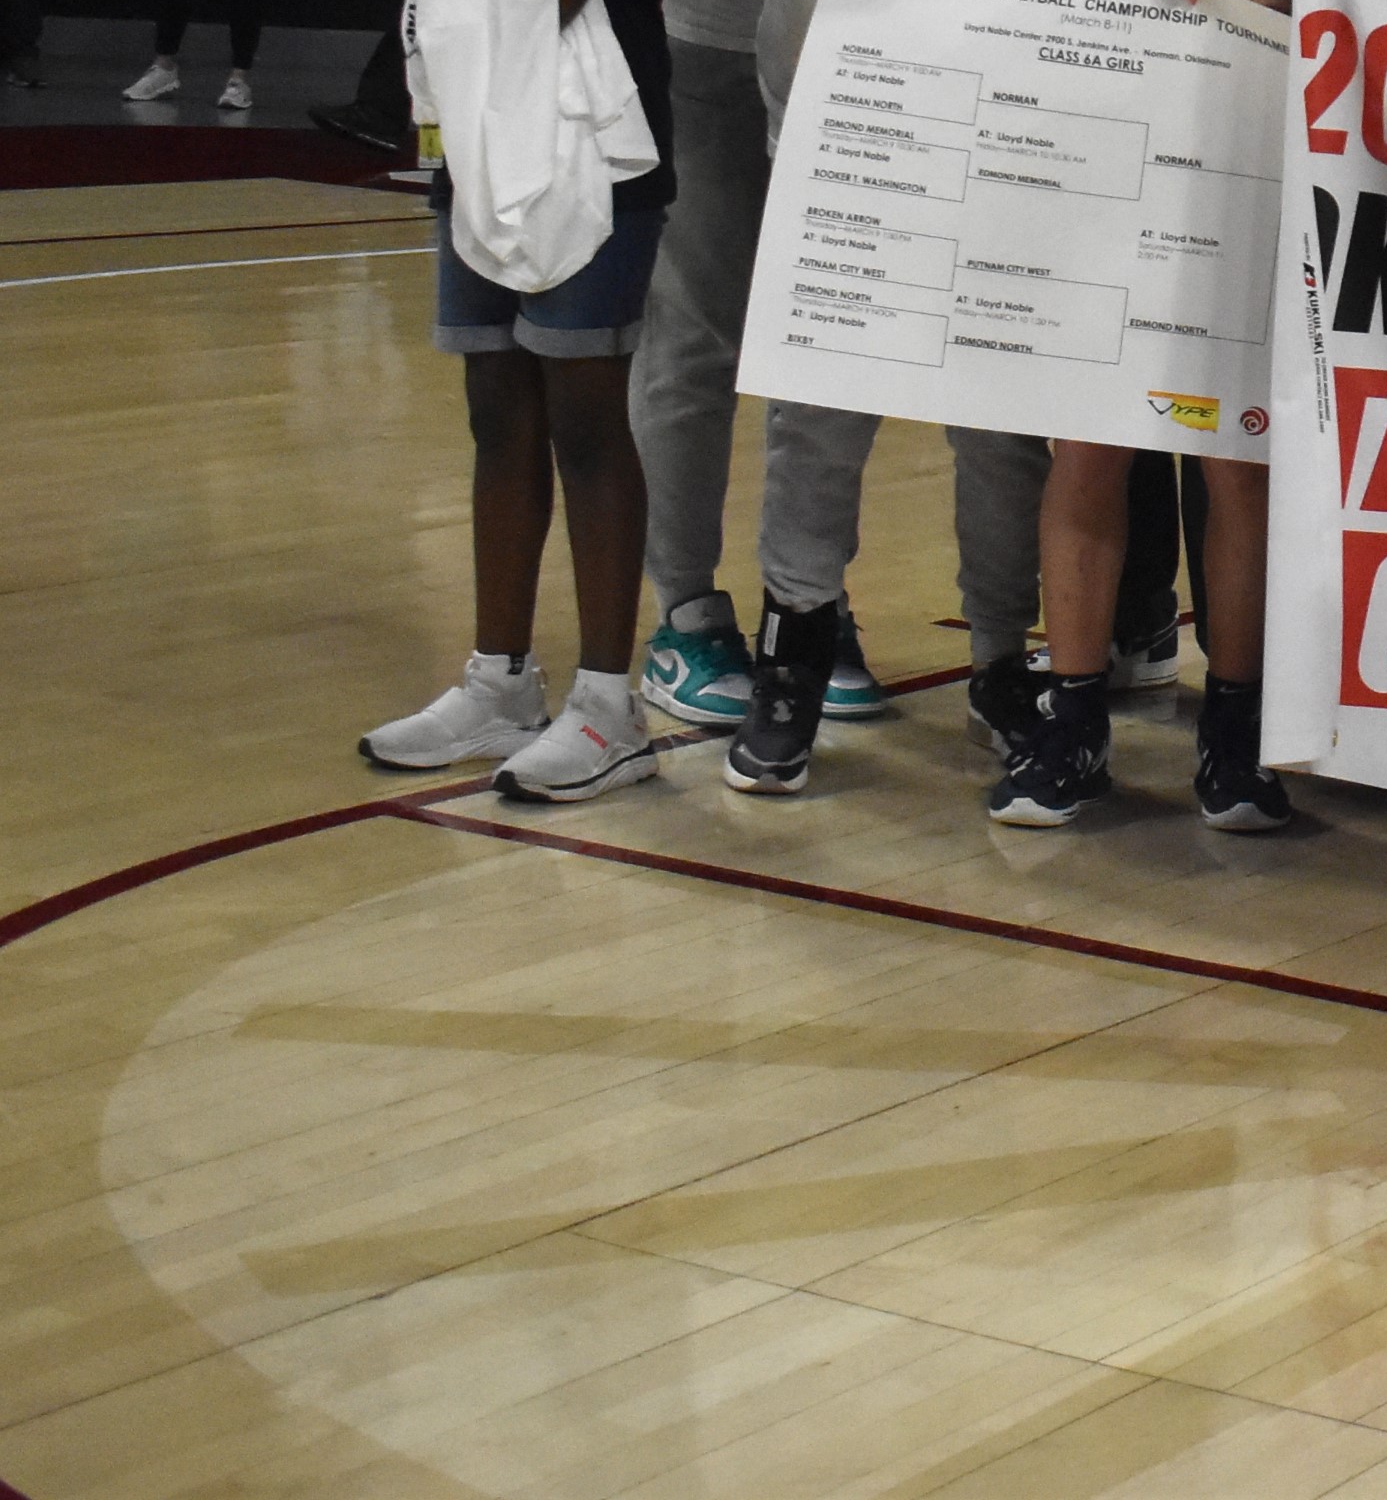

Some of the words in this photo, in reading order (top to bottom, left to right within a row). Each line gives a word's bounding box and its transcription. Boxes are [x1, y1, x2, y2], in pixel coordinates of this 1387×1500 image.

[842, 44, 883, 57] NORMAN
[988, 26, 1012, 37] Noble
[1077, 38, 1110, 51] Jenkins
[1184, 54, 1232, 70] Oklahoma
[1038, 47, 1080, 65] CLASS
[1083, 54, 1101, 68] 6A
[1106, 57, 1145, 74] GIRLS
[879, 74, 906, 86] Noble
[830, 92, 871, 107] NORMAN
[872, 98, 904, 112] NORTH
[992, 91, 1039, 106] NORMAN
[823, 118, 865, 132] EDMOND
[866, 124, 915, 141] MEMORIAL
[997, 132, 1023, 145] Lloyd
[1025, 136, 1056, 149] Noble
[863, 149, 891, 163] Noble
[1154, 154, 1203, 169] NORMAN
[814, 168, 851, 183] BOOKER
[862, 175, 927, 194] WASHINGTON
[978, 168, 1017, 182] EDMOND
[1017, 174, 1062, 189] MEMORIAL
[807, 206, 844, 221] BROKEN
[846, 213, 882, 227] ARROW
[848, 239, 877, 252] Noble
[1160, 231, 1187, 244] Lloyd
[1189, 236, 1220, 248] Noble
[799, 257, 838, 272] PUTNAM
[839, 263, 860, 275] CITY
[862, 266, 887, 279] WEST
[967, 259, 1005, 272] PUTNAM
[1006, 264, 1026, 275] CITY
[1027, 267, 1051, 277] WEST
[794, 283, 838, 298] EDMOND
[840, 289, 873, 303] NORTH
[975, 297, 1002, 310] Lloyd
[1004, 301, 1035, 314] Noble
[838, 316, 867, 329] Noble
[1129, 318, 1173, 331] EDMOND
[1174, 323, 1208, 337] NORTH
[1306, 290, 1324, 355] KUKULSKI
[787, 333, 815, 346] BIXBY
[954, 335, 998, 350] EDMOND
[999, 341, 1034, 354] NORTH
[1147, 398, 1216, 419] VYPE
